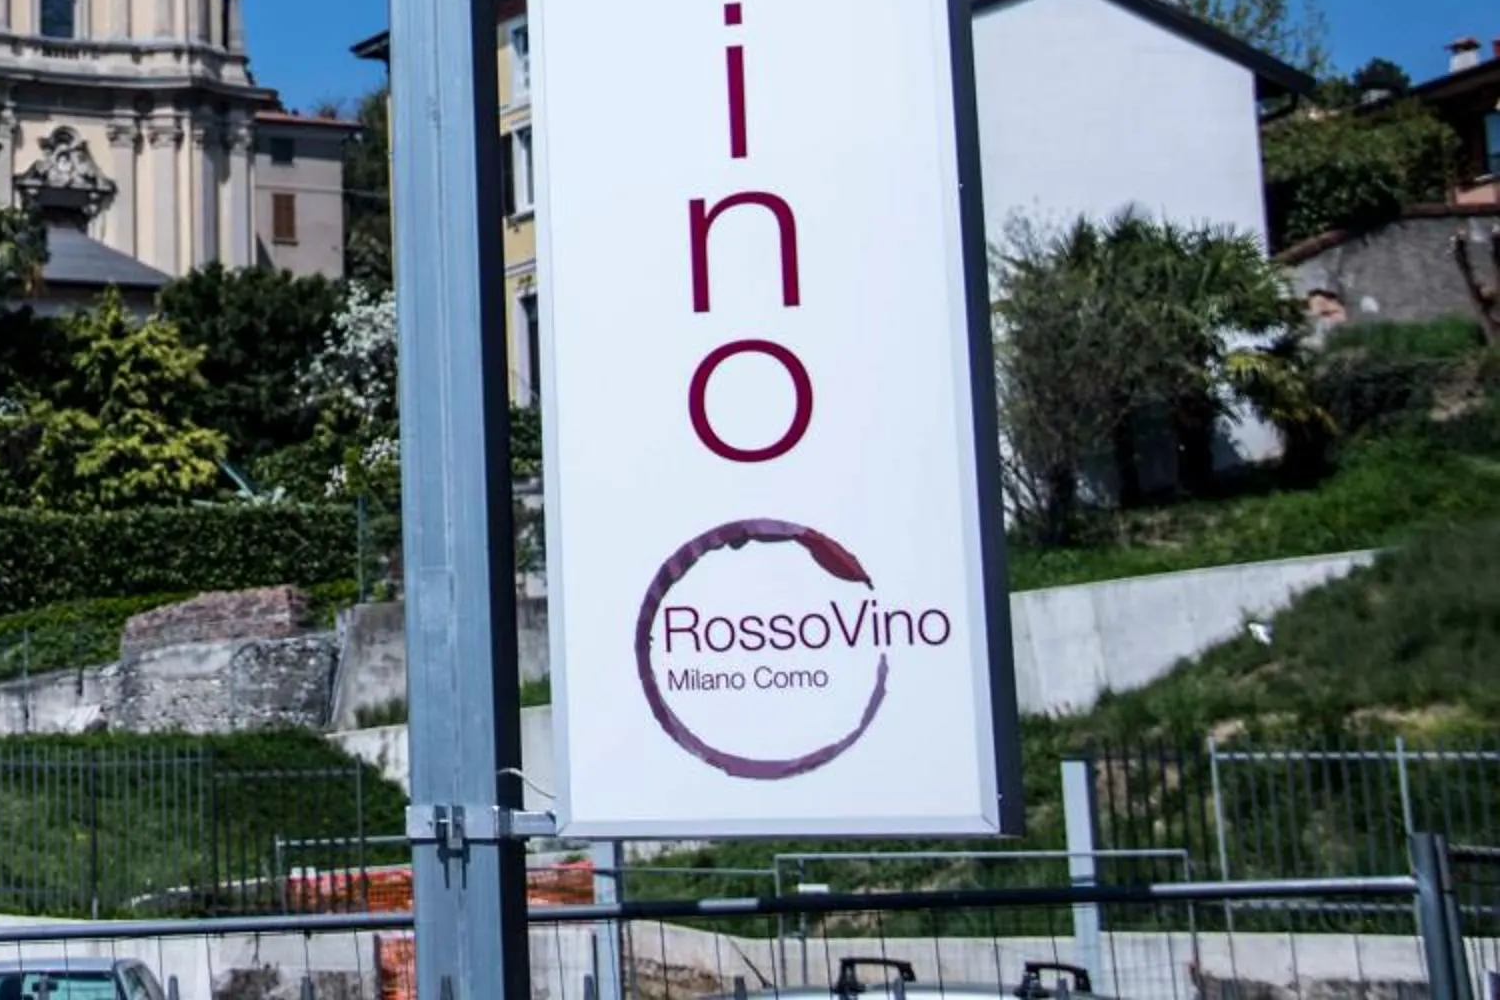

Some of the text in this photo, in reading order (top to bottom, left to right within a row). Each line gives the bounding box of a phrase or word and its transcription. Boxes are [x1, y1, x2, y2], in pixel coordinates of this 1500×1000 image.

[664, 600, 951, 654] RossoVino
[667, 665, 829, 691] Milano Como
